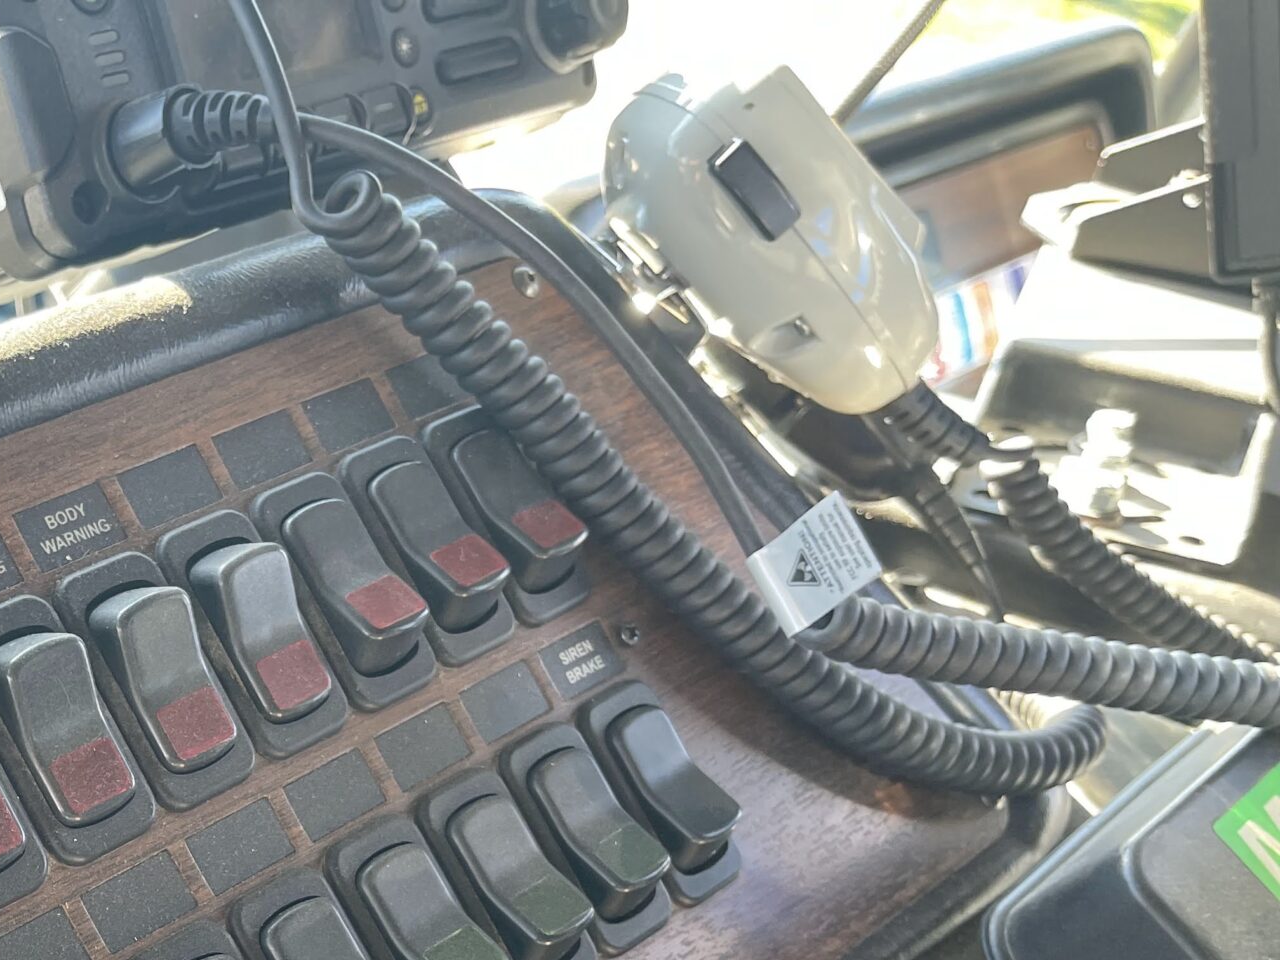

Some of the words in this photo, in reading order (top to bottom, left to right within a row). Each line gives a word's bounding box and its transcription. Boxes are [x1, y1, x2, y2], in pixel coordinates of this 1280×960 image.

[43, 502, 86, 530] BODY
[39, 518, 111, 555] WARNING
[558, 640, 594, 666] SIREN
[565, 655, 605, 684] BRAKE
